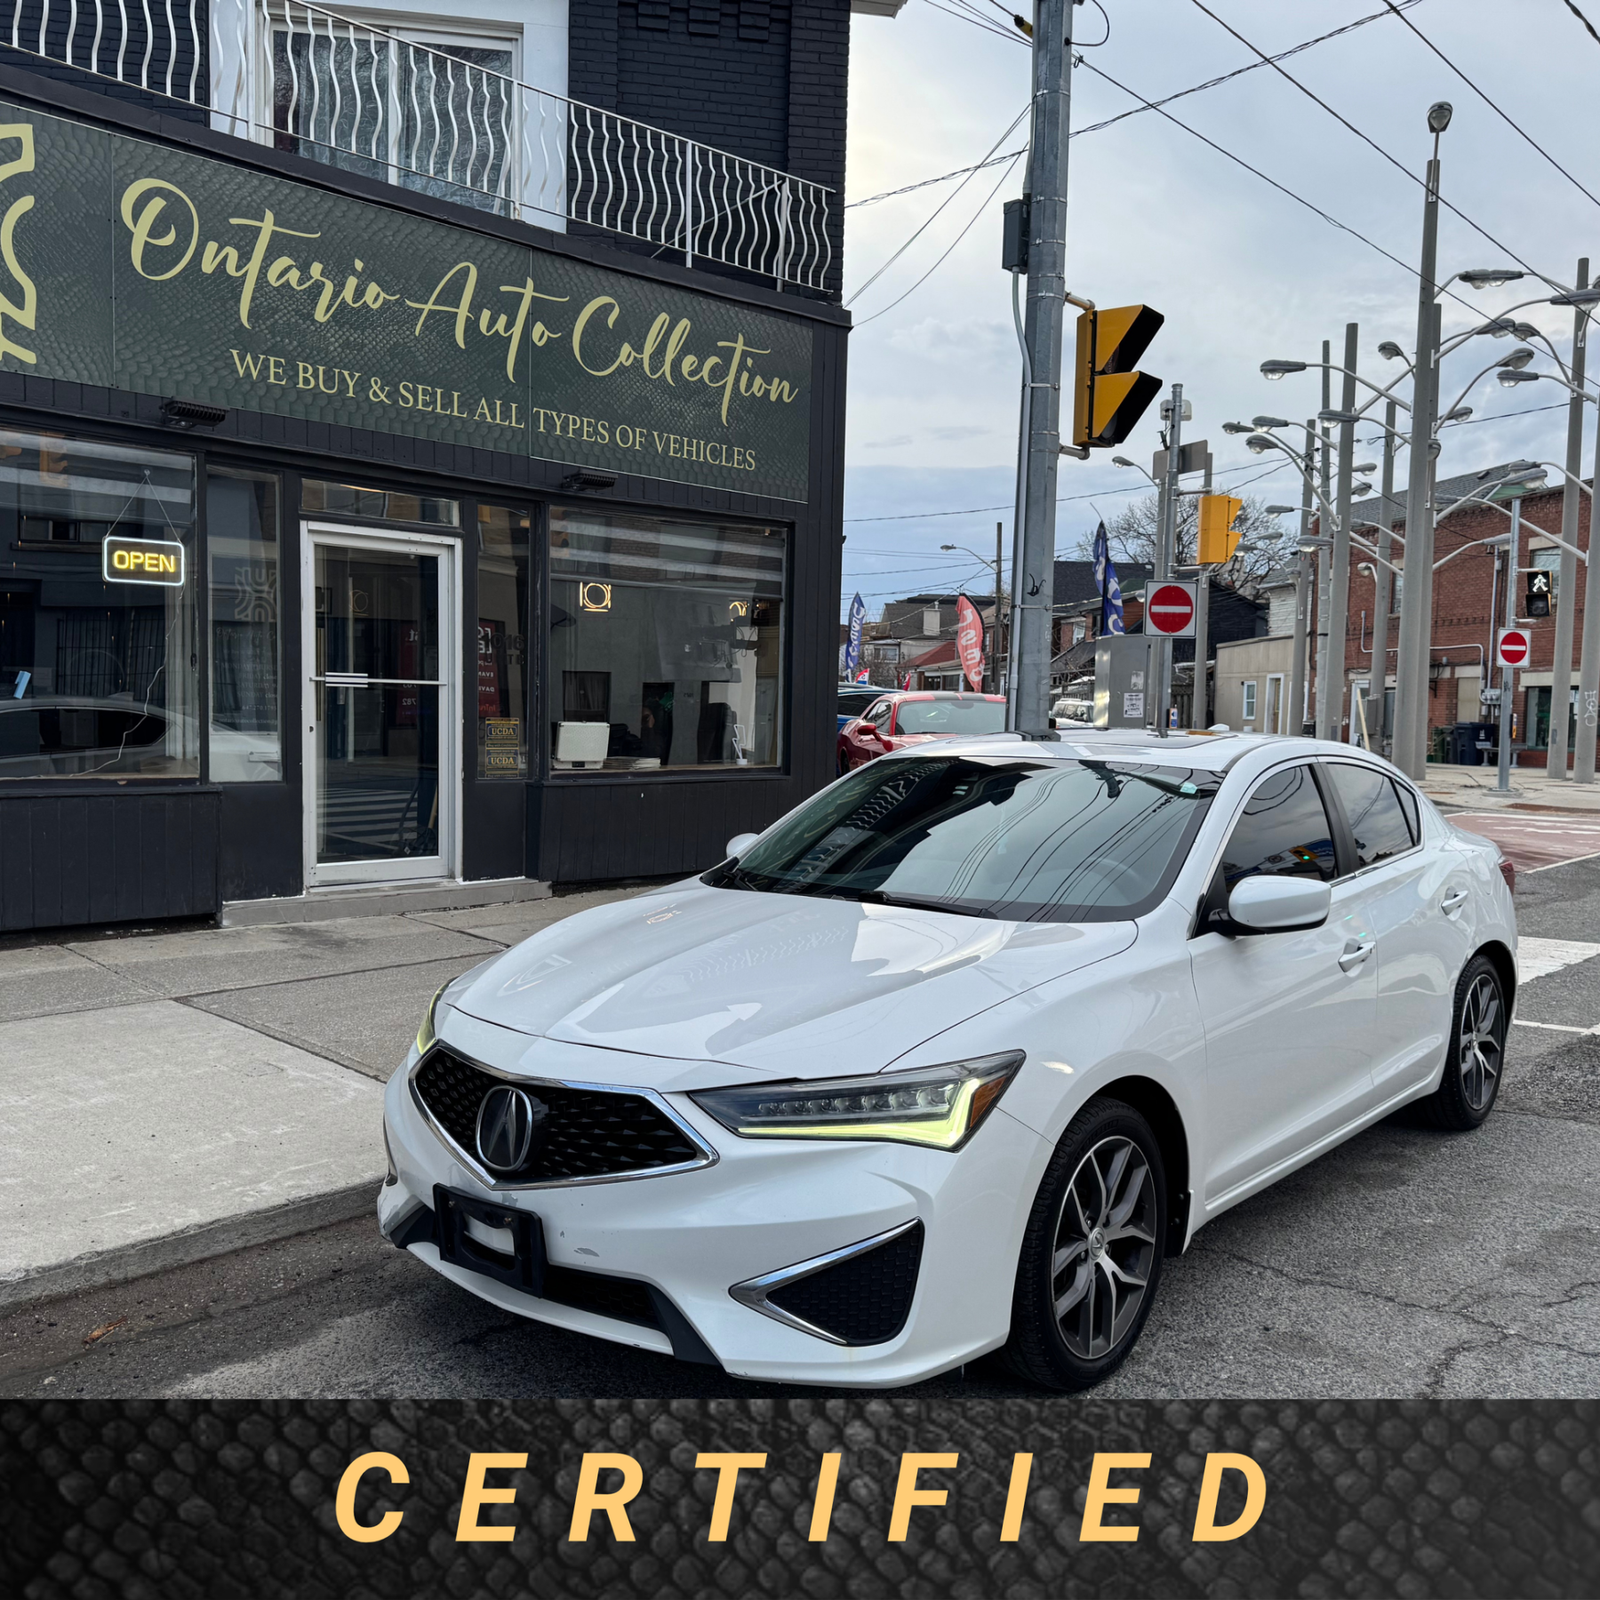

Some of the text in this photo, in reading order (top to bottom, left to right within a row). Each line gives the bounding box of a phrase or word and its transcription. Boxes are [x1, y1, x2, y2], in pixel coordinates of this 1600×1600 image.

[121, 178, 798, 426] Ontario Auto Collection
[229, 349, 756, 470] WE BUY & SELL ALL TYPES OF VEHICLES
[113, 550, 175, 572] OPEN
[490, 757, 515, 765] UCDA
